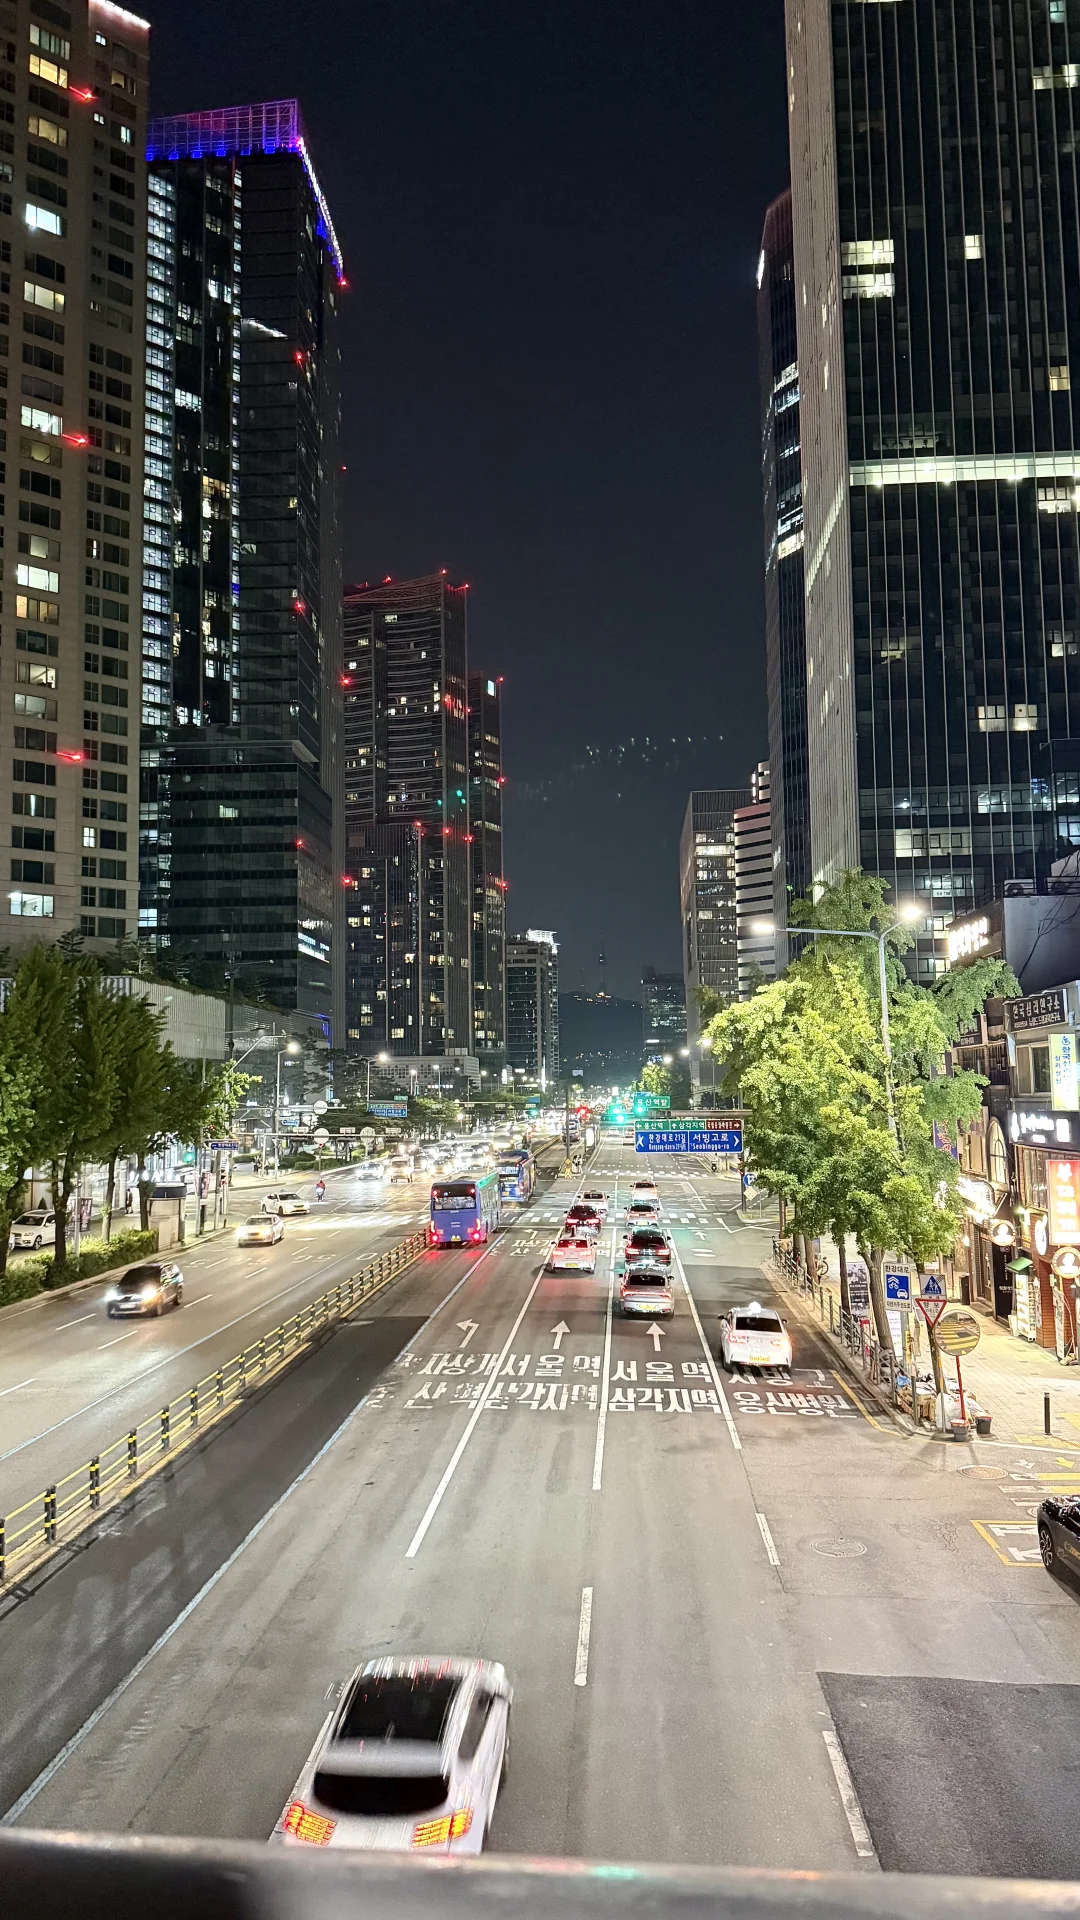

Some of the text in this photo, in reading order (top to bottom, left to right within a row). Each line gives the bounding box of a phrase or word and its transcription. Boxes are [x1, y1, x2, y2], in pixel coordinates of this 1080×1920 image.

[678, 1121, 705, 1130] 삼각지역
[692, 1133, 729, 1143] 서빙고로
[885, 1265, 910, 1274] 한강대로
[499, 1354, 600, 1378] 서울역
[610, 1360, 714, 1383] 서울역
[608, 1387, 722, 1414] 삼각지역
[732, 1391, 858, 1418] 용산병원
